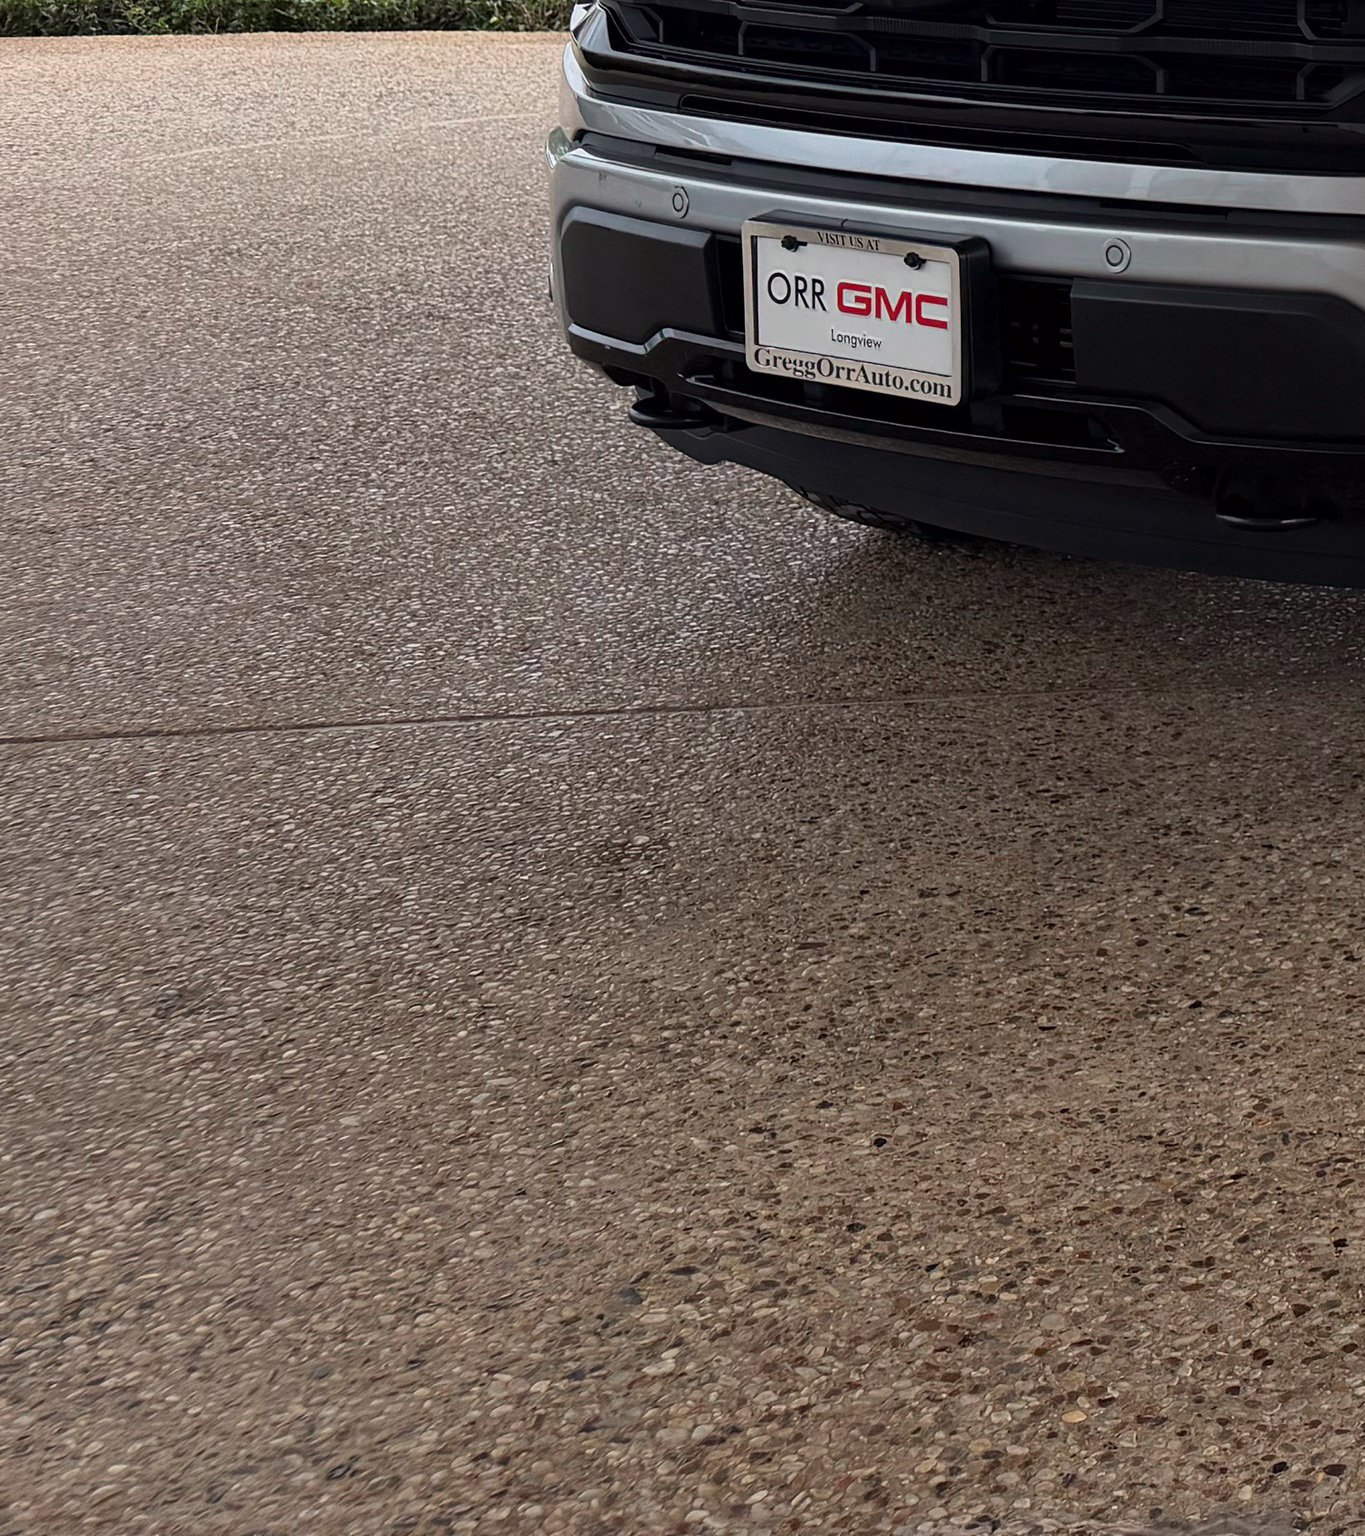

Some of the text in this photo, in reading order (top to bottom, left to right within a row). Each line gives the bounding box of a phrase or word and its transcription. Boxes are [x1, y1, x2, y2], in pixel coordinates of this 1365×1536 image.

[817, 231, 881, 251] VISIT US AT
[767, 272, 949, 330] ORR GMC
[831, 328, 883, 350] Longview
[753, 347, 953, 399] GreggOrrAuto.com
